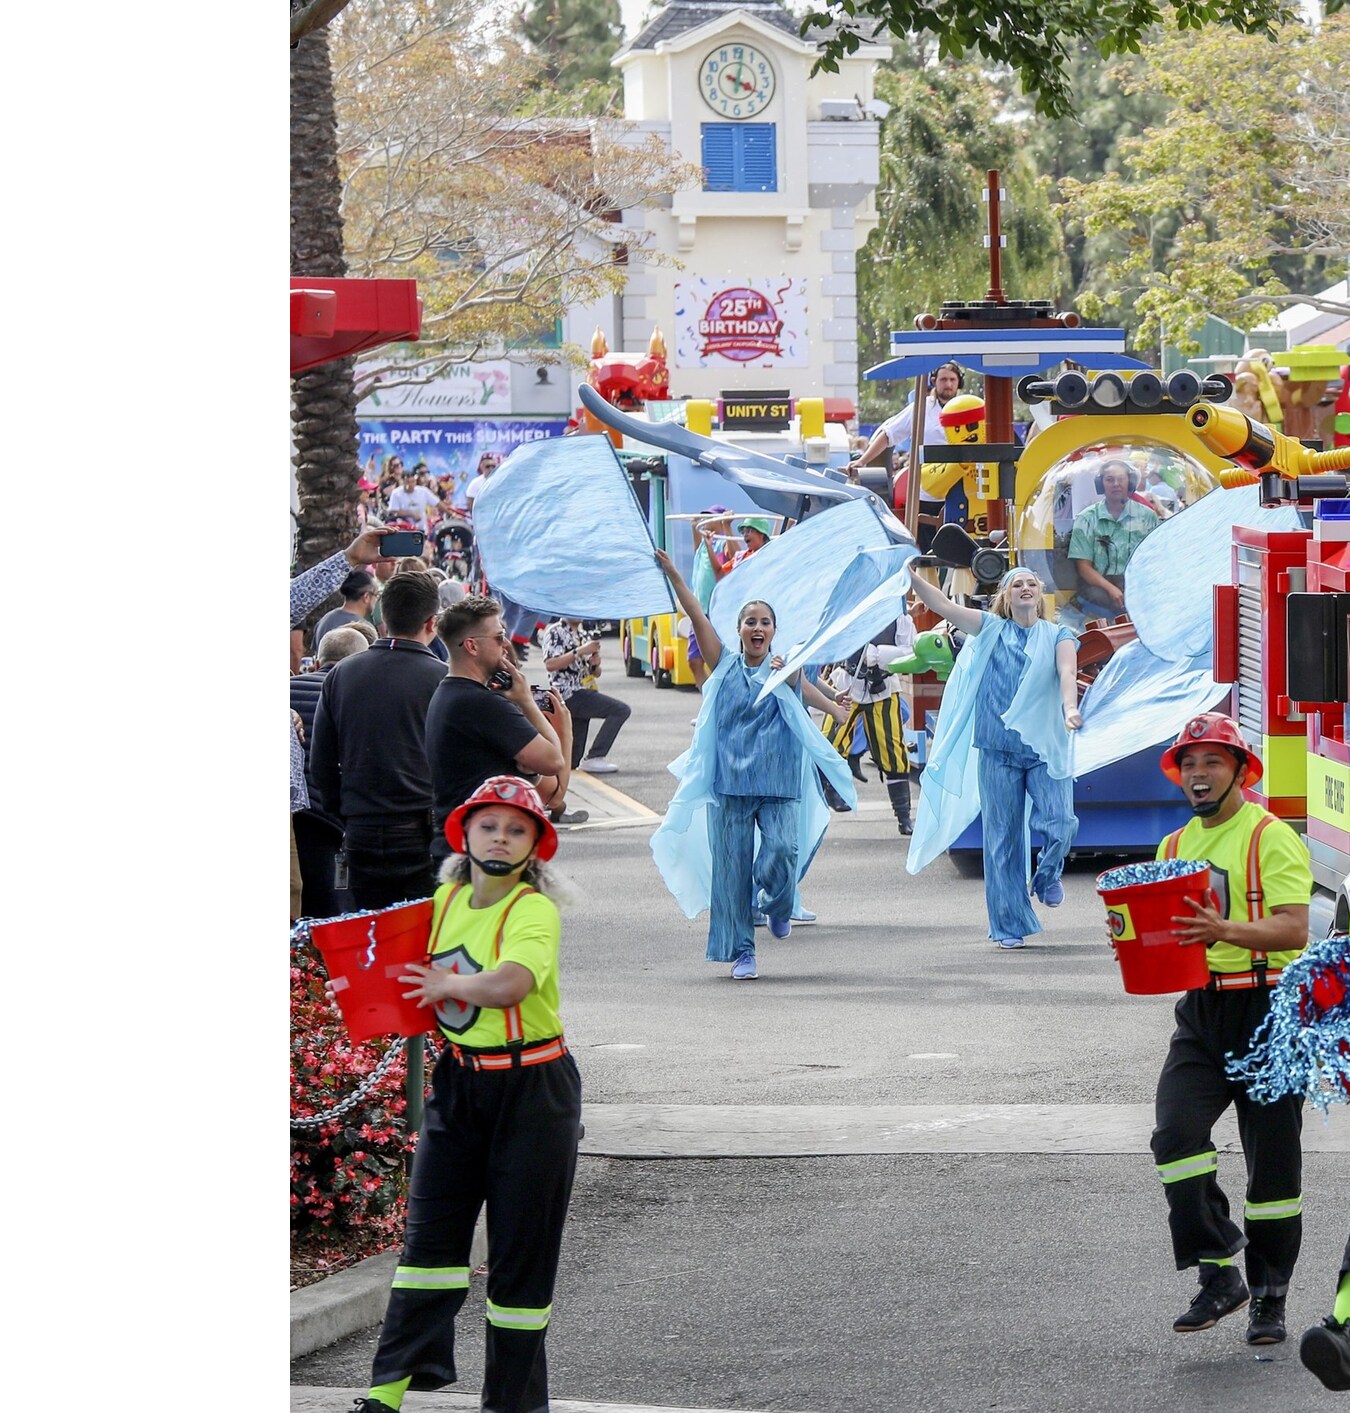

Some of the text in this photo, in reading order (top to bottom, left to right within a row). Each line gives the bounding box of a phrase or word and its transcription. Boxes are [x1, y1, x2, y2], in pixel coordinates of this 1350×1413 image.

[720, 50, 727, 62] 11
[750, 51, 754, 63] 1
[709, 60, 718, 72] 10
[759, 62, 766, 74] 2
[705, 74, 713, 86] 9
[762, 76, 769, 88] 3
[709, 88, 717, 100] 8
[756, 91, 766, 102] 4
[720, 100, 727, 112] 7
[733, 104, 740, 116] 6
[748, 100, 755, 113] 5
[720, 299, 762, 317] 25TH
[699, 320, 779, 334] BIRTHDAY
[390, 366, 419, 377] FUN
[726, 405, 788, 417] UNITY ST
[362, 432, 387, 444] THE
[390, 429, 443, 444] PARTY
[444, 432, 473, 444] THIS
[476, 429, 550, 443] SUMMER!
